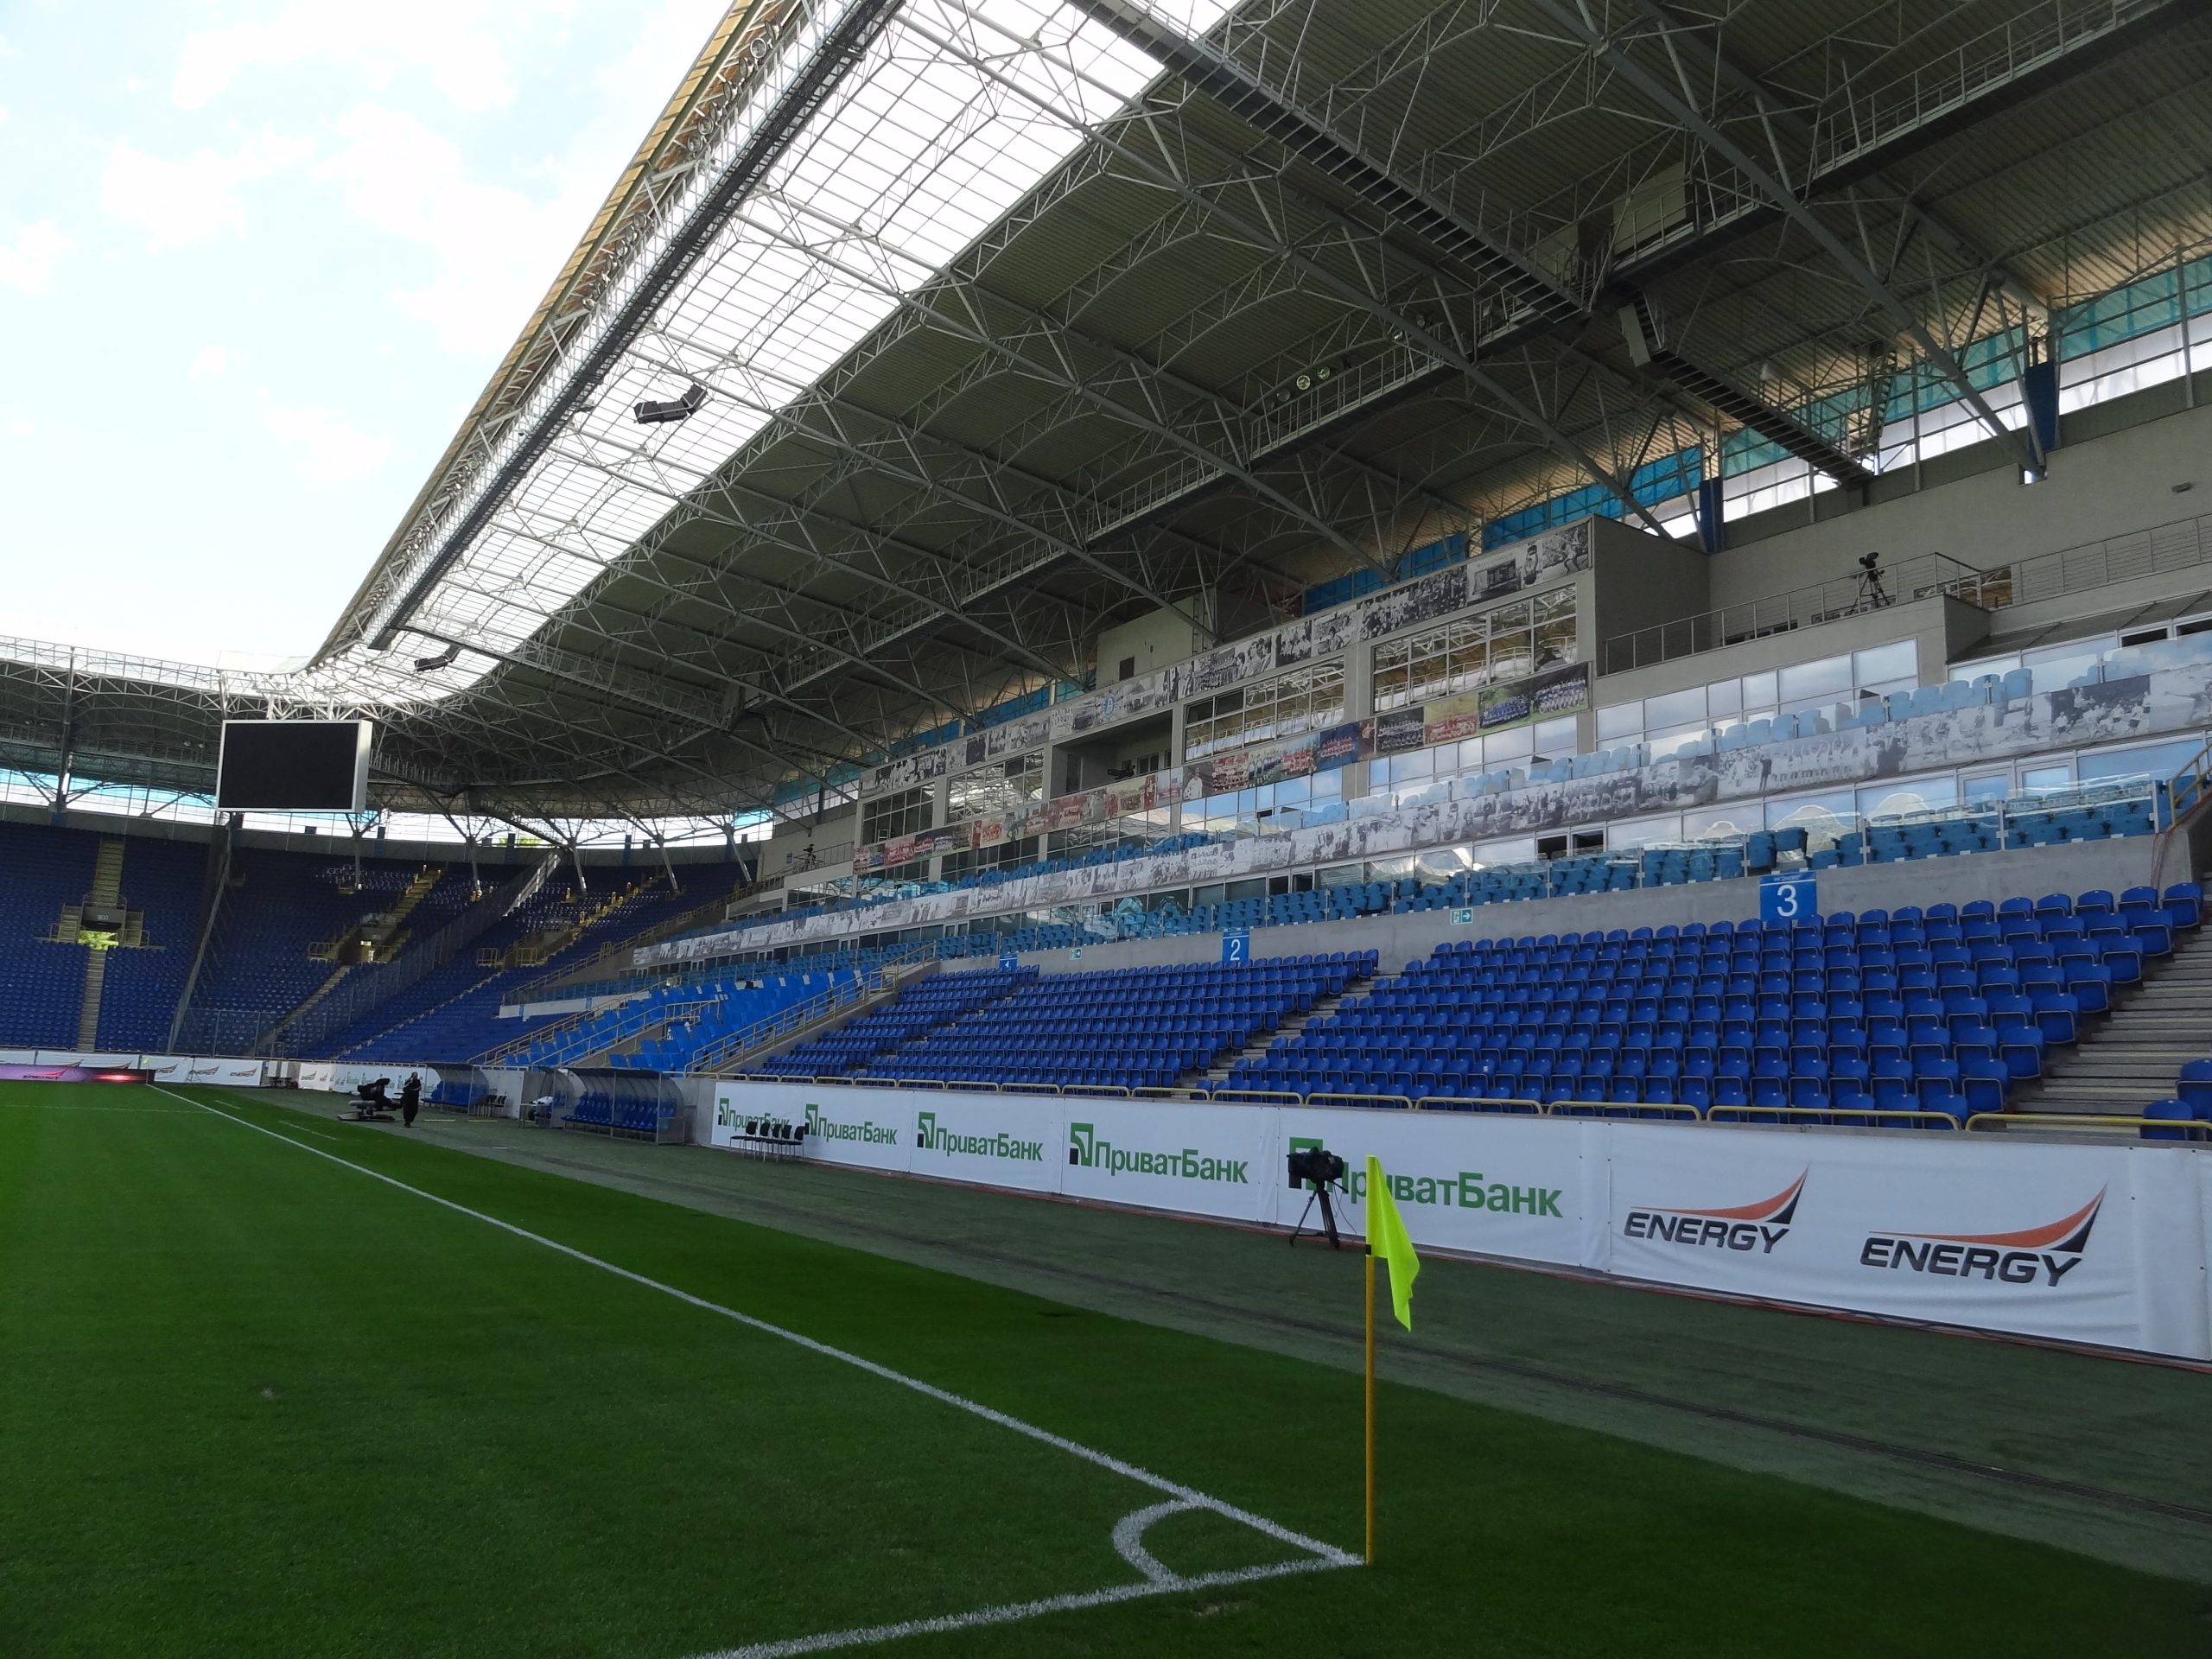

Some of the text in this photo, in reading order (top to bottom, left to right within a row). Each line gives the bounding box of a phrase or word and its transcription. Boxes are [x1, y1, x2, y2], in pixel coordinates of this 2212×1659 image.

[1777, 884, 1798, 917] 3
[1230, 938, 1241, 961] 2
[818, 1116, 898, 1145] ПриватБанк
[935, 1127, 1044, 1161] ПриватБанк
[1095, 1141, 1249, 1184] ПриватБанк
[1624, 1211, 1790, 1254] ENERGY
[1859, 1237, 2082, 1287] ENERGY
